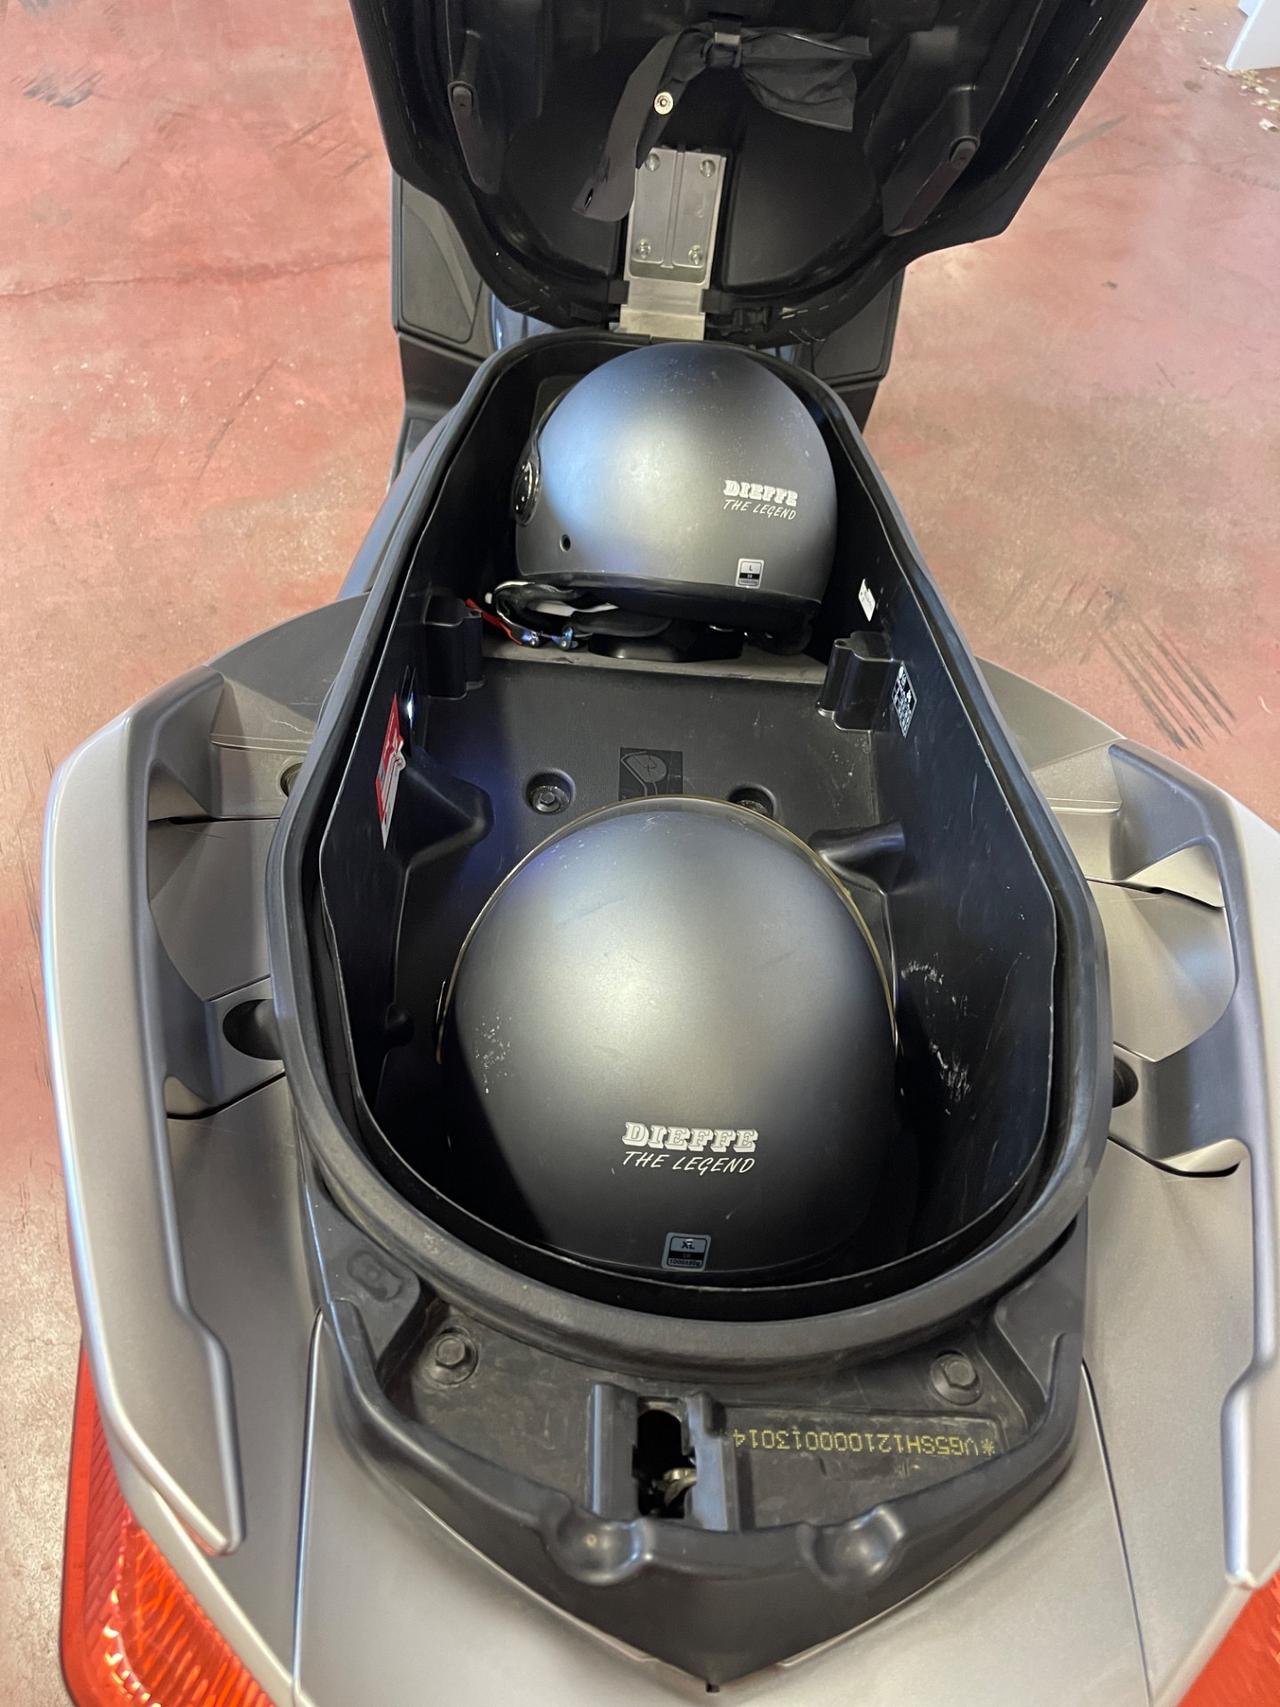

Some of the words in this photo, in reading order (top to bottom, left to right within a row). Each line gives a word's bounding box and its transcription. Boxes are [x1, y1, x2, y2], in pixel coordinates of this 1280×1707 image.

[723, 479, 798, 507] DIEFFE
[723, 499, 752, 512] THE
[753, 503, 797, 520] LEGEND
[621, 1121, 759, 1153] DIEFFE
[622, 1151, 670, 1168] THE
[672, 1156, 756, 1176] LEGEND
